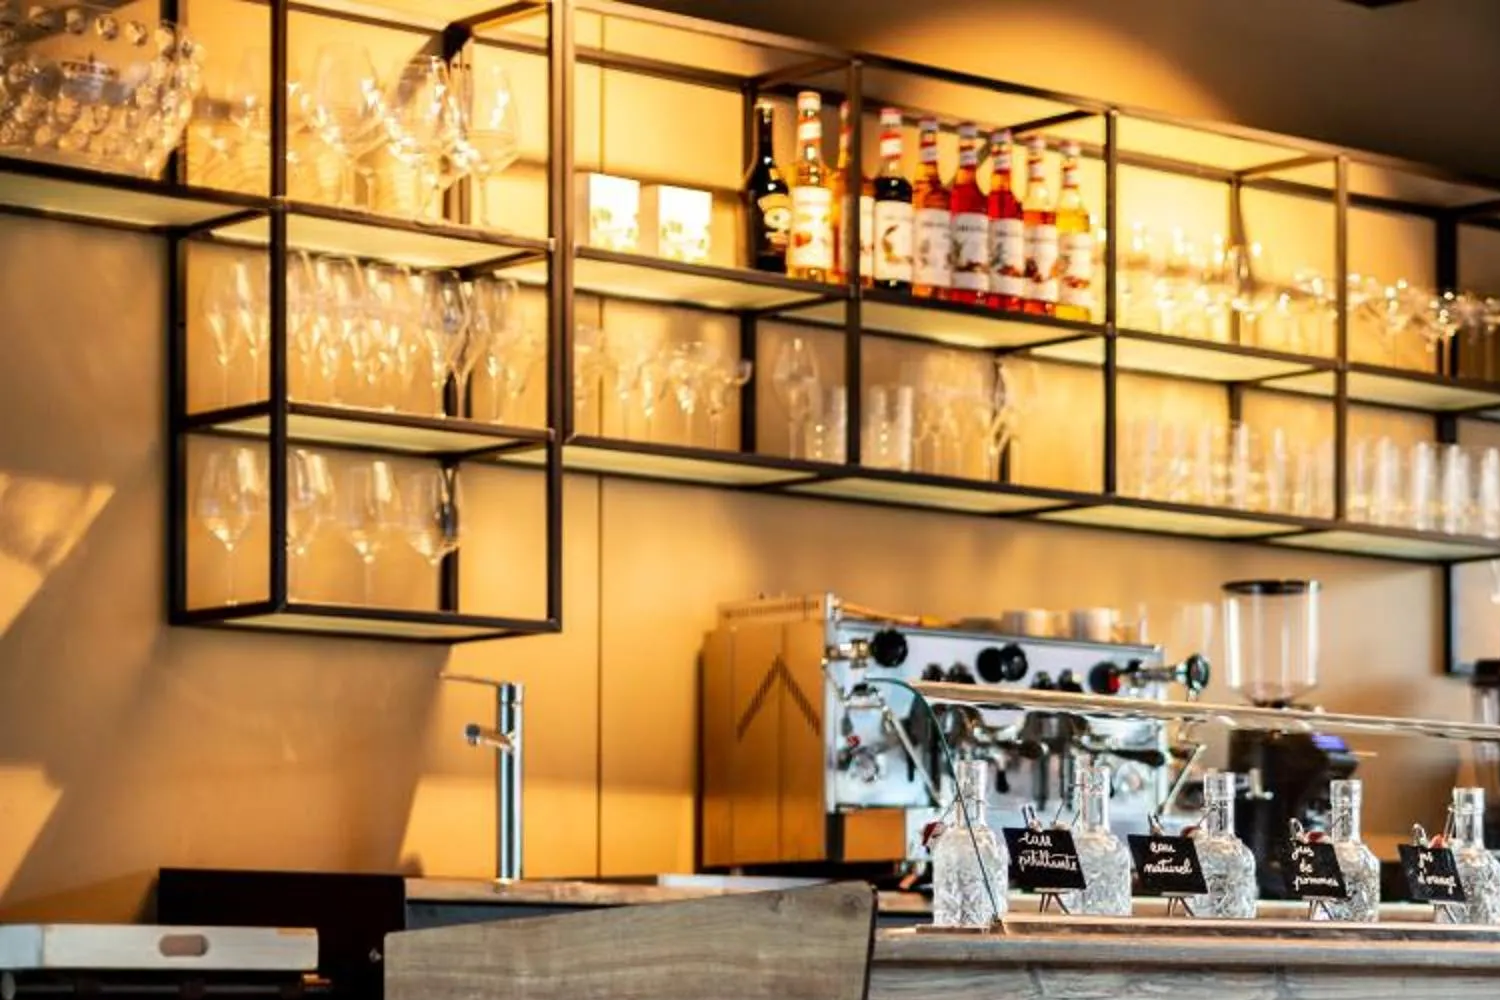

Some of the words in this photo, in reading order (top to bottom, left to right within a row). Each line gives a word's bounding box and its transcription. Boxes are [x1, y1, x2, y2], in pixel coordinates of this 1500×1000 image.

[1018, 832, 1052, 847] eau
[1149, 841, 1176, 853] eau
[1143, 858, 1193, 875] naturel
